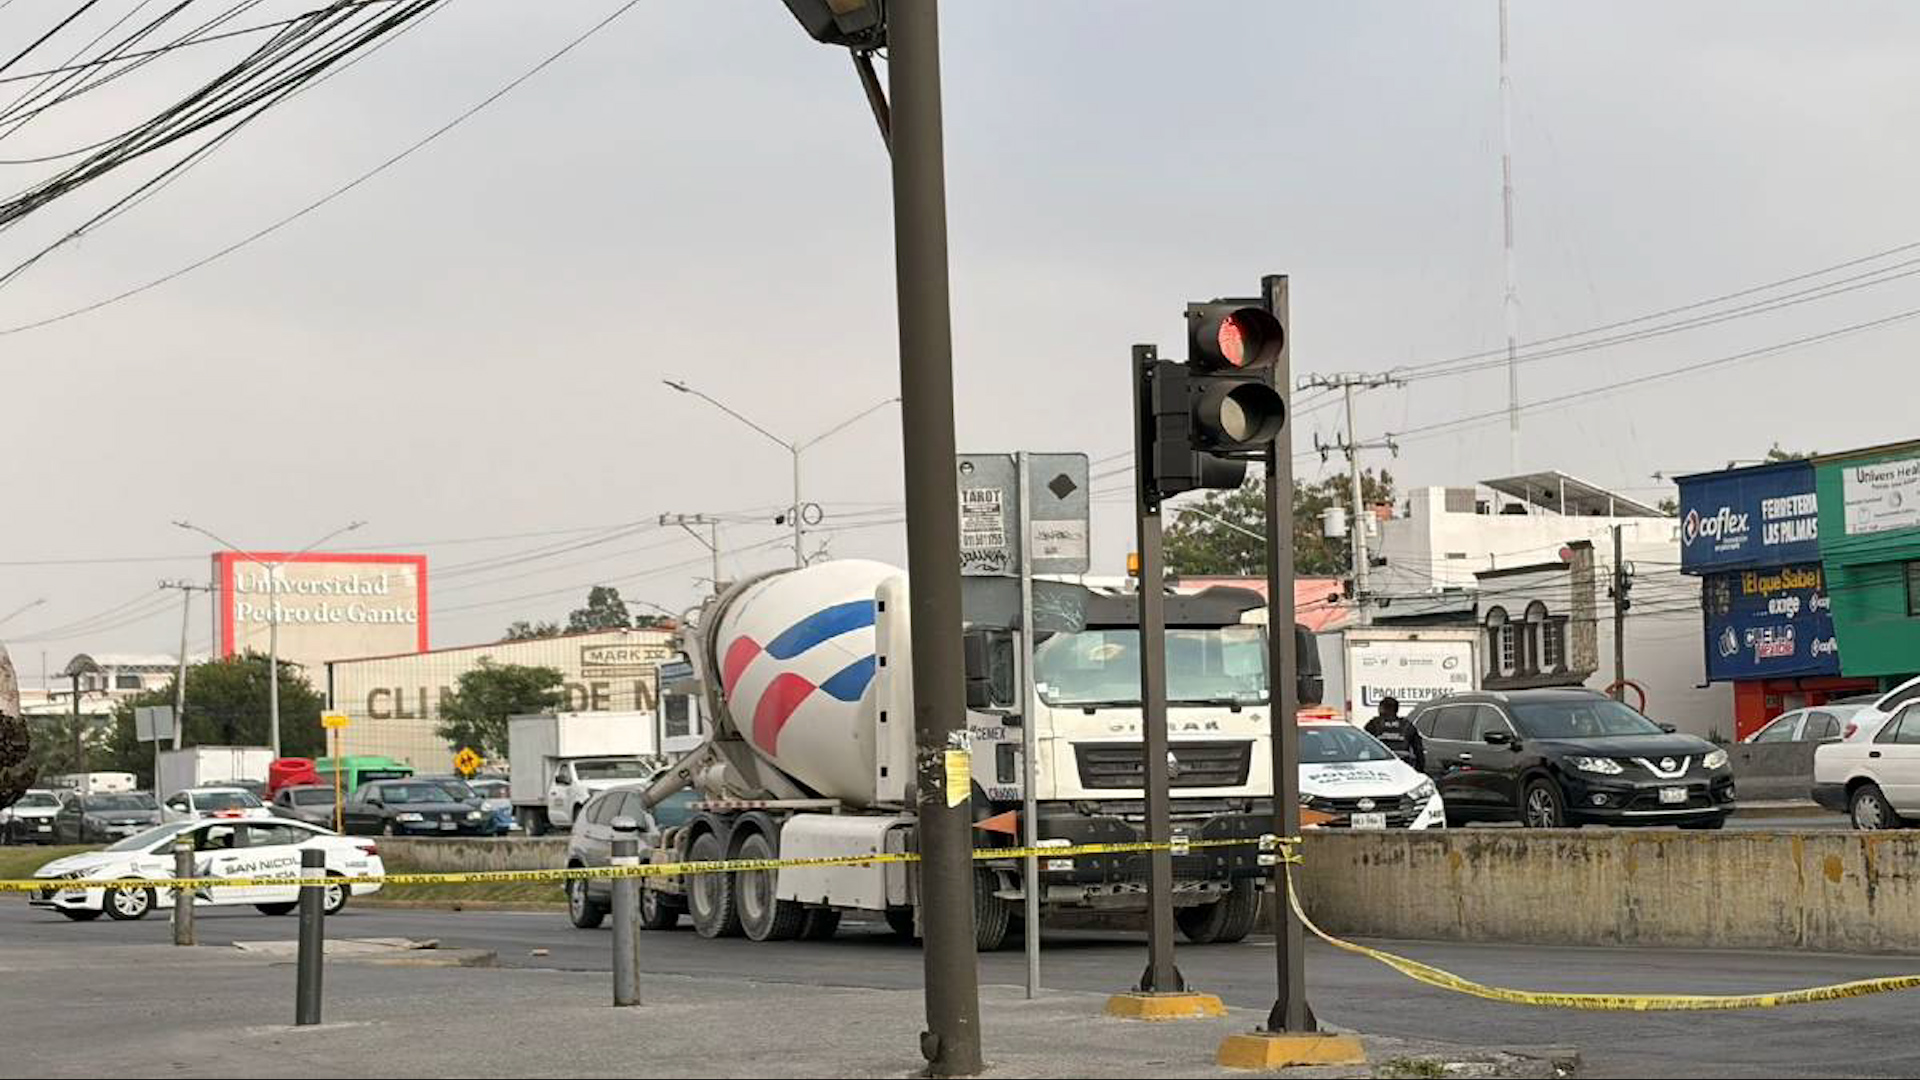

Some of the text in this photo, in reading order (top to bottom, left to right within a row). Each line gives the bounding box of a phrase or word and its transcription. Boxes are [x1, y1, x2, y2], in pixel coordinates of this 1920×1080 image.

[1856, 467, 1894, 483] Univers
[962, 490, 1000, 502] TAROT
[1763, 522, 1779, 545] LAS
[1780, 518, 1818, 543] PALMAS
[236, 573, 388, 595] Universidad
[1759, 574, 1781, 597] que
[236, 602, 418, 624] Pedro de Gante
[591, 650, 666, 661] MARK IV
[563, 682, 610, 712] DE
[976, 727, 1005, 740] CEMEX
[226, 857, 301, 874] SAN NICOL
